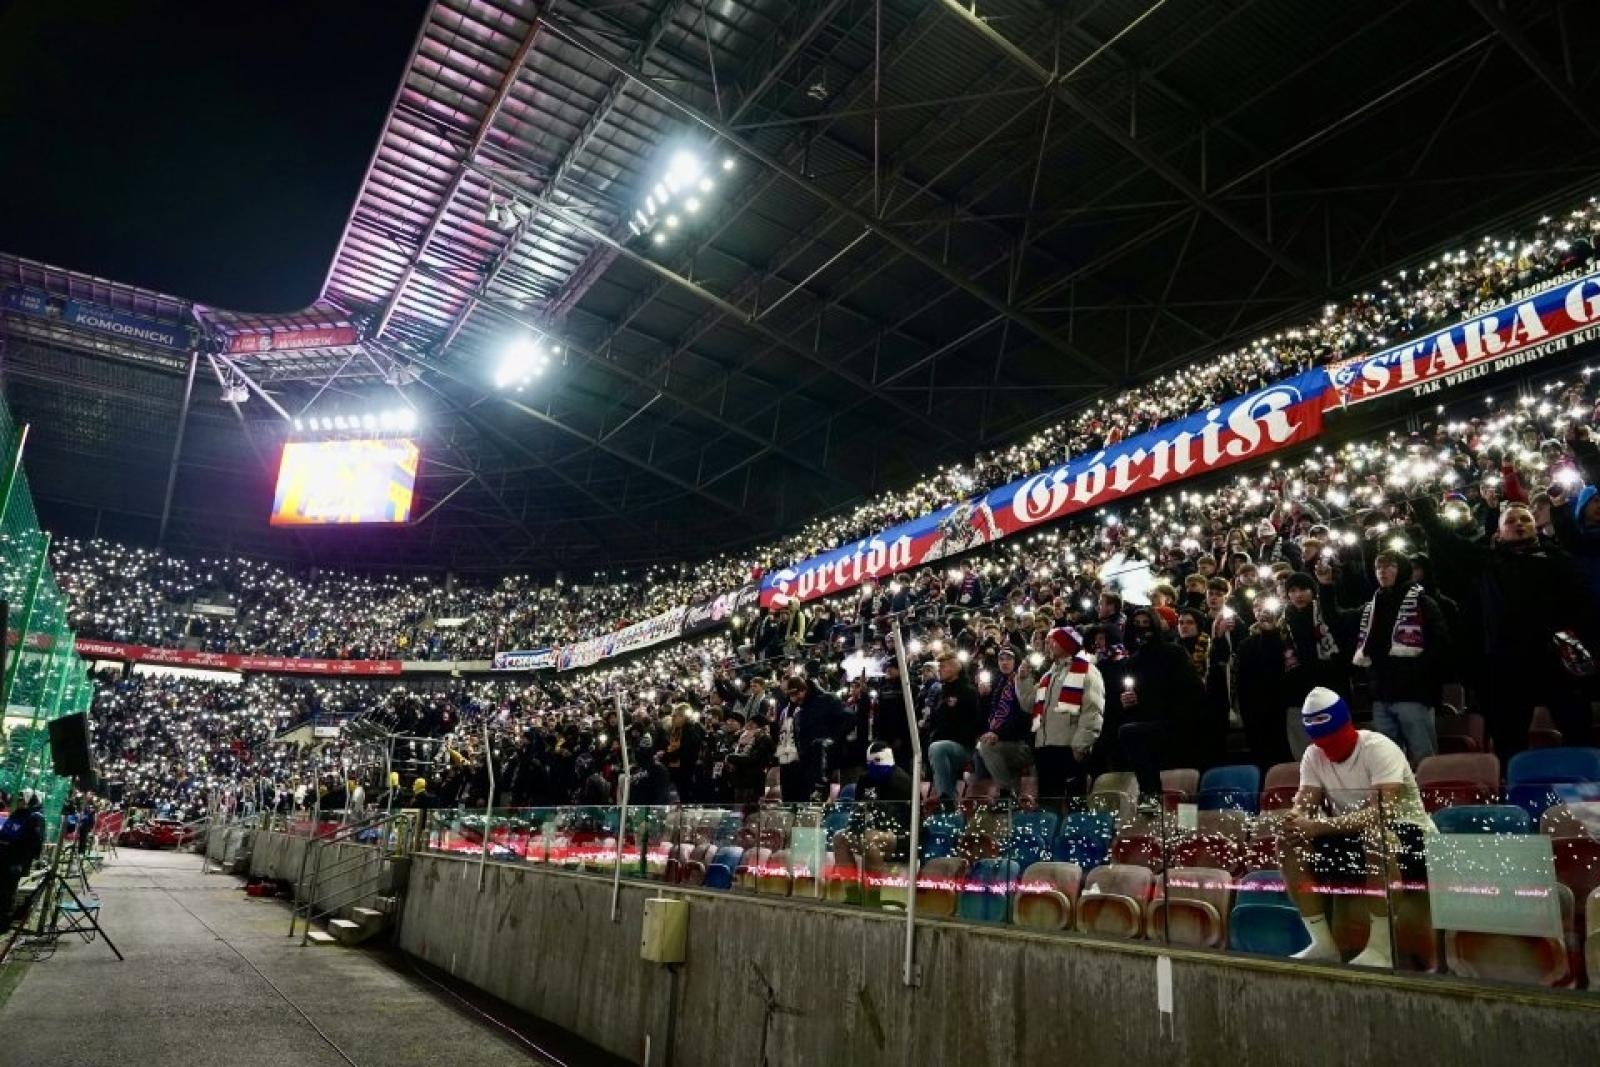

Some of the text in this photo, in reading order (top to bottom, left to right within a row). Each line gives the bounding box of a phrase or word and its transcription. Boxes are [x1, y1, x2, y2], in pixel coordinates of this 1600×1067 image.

[75, 313, 175, 345] KOMORNICKI
[1361, 301, 1548, 396] STARA
[1413, 380, 1441, 397] TAK
[1445, 363, 1490, 387] WIELU
[1494, 337, 1568, 372] DOBRYCH
[769, 533, 915, 608] Torcida
